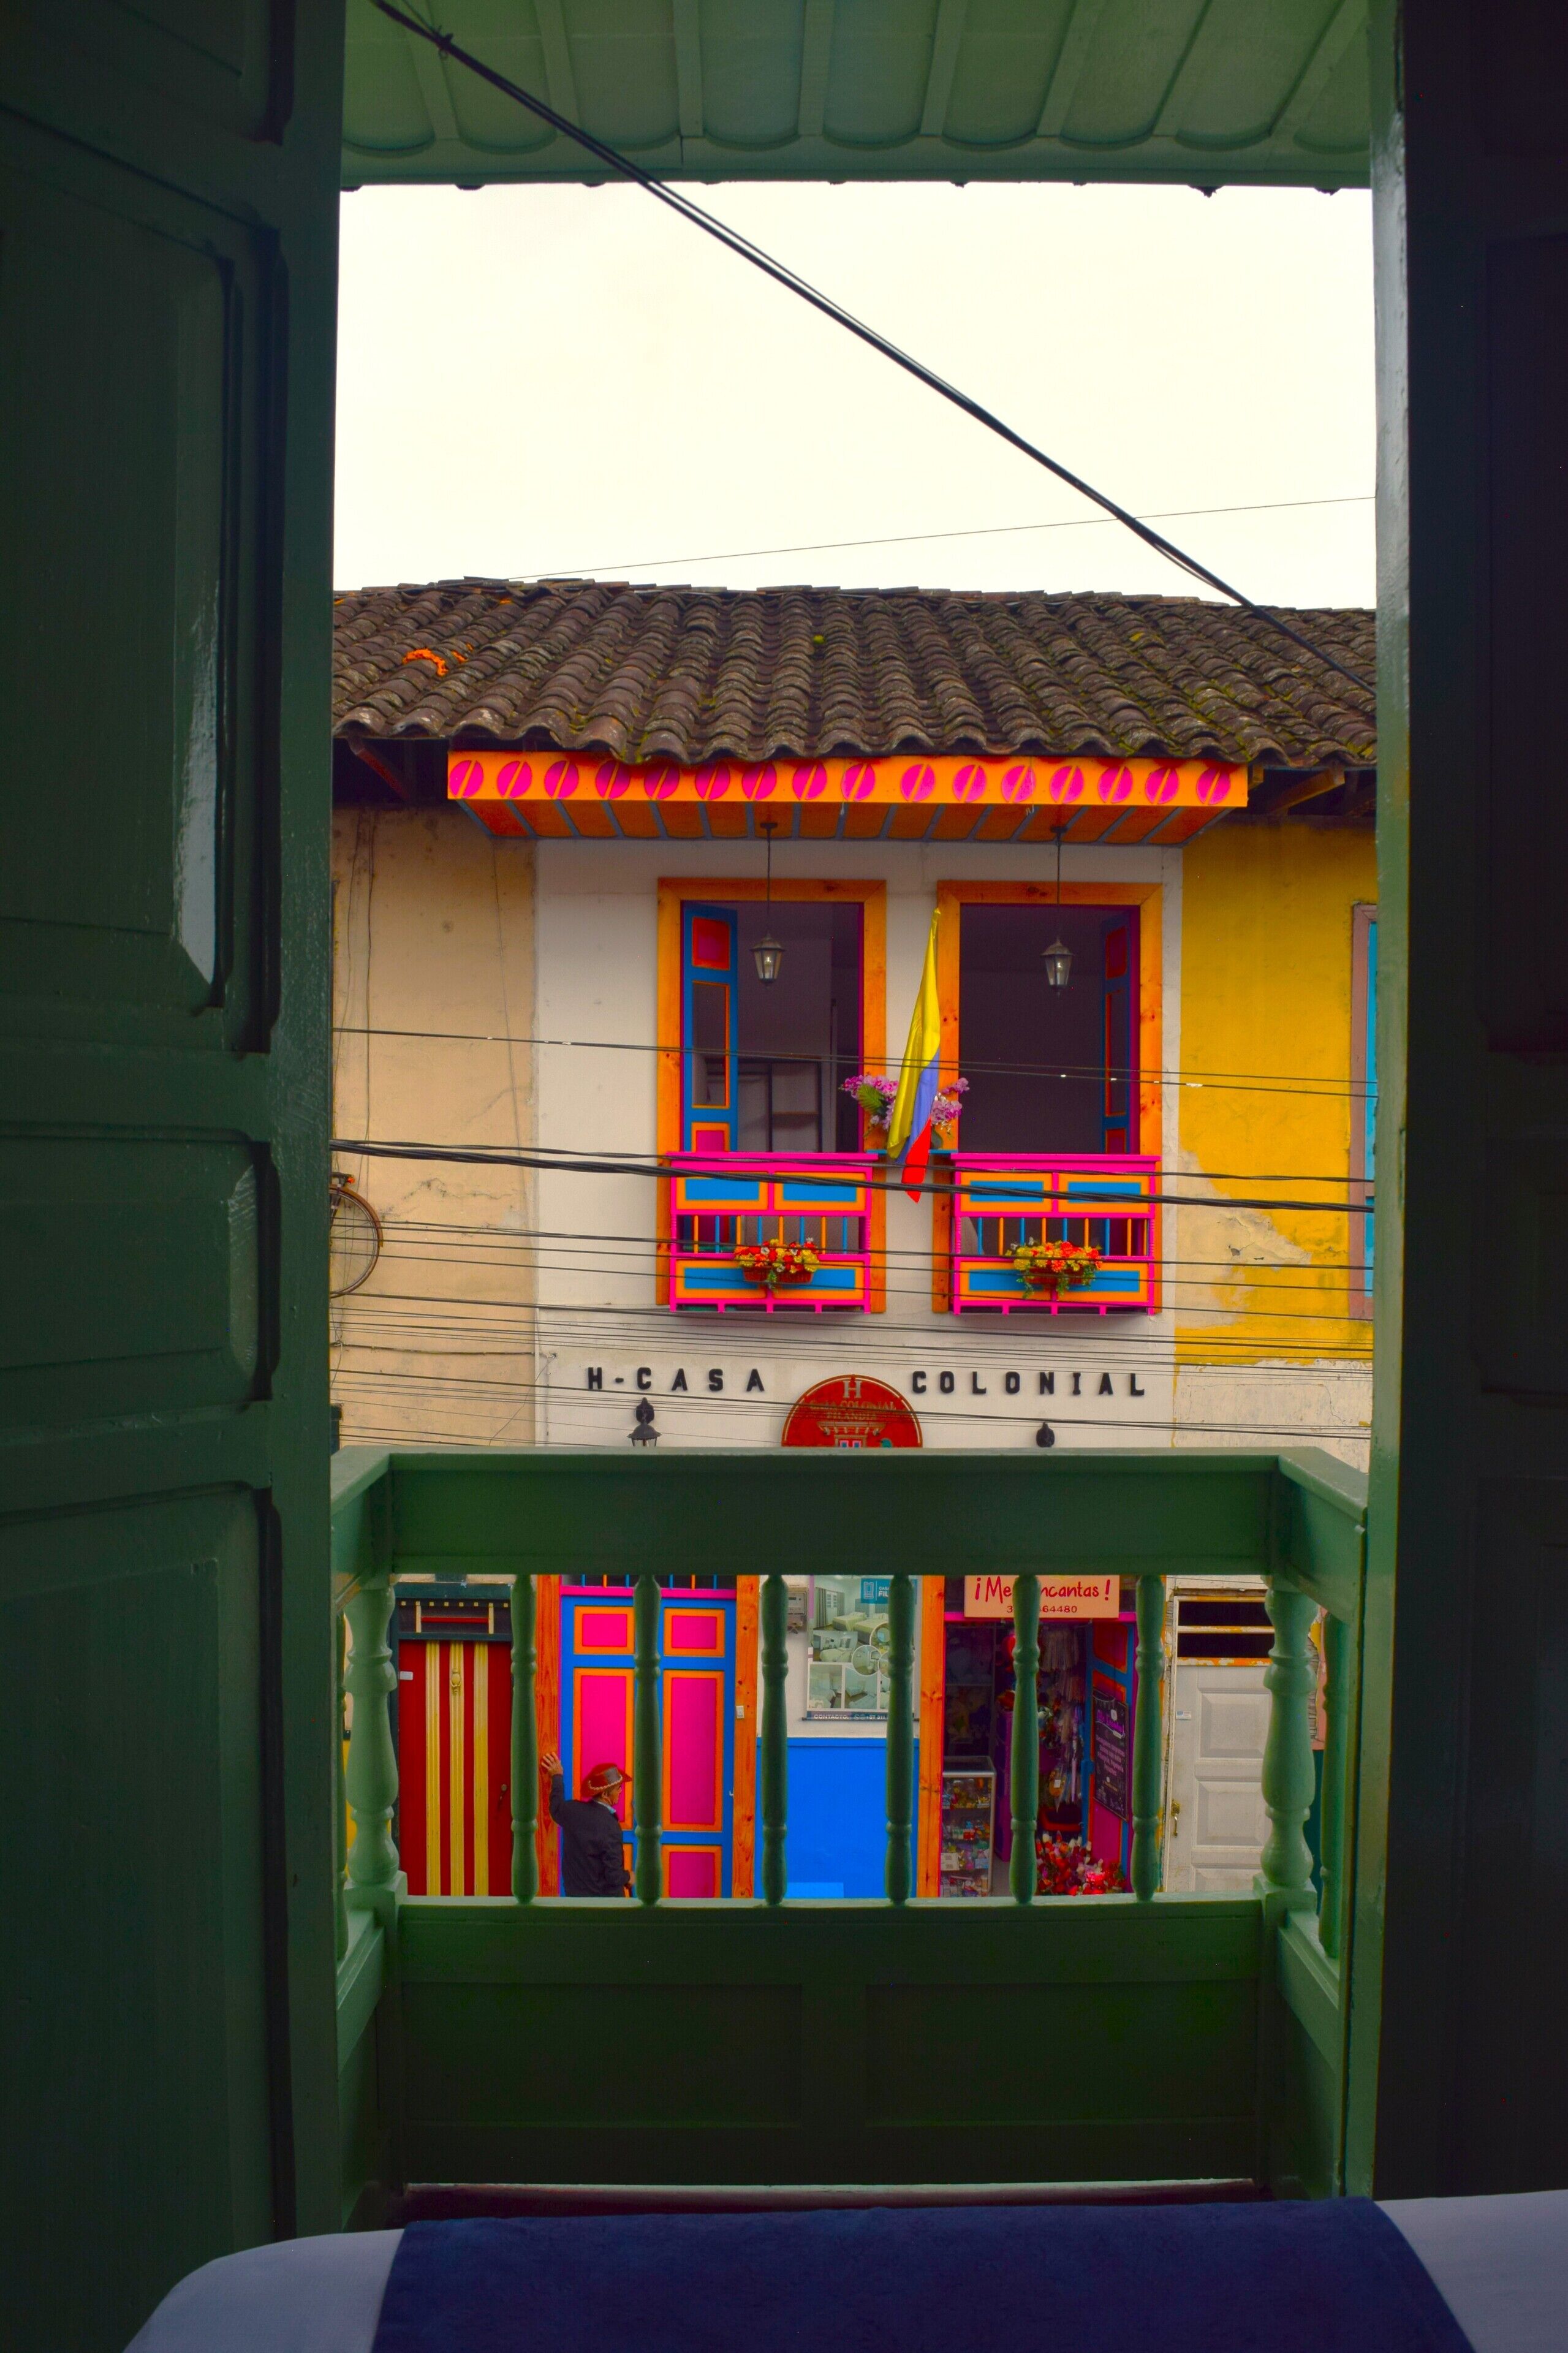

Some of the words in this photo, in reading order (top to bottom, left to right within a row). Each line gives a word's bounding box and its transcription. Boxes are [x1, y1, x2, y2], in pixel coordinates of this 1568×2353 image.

[588, 1366, 765, 1392] H-CASA
[912, 1370, 1145, 1396] COLONIAL
[843, 1381, 862, 1399] H
